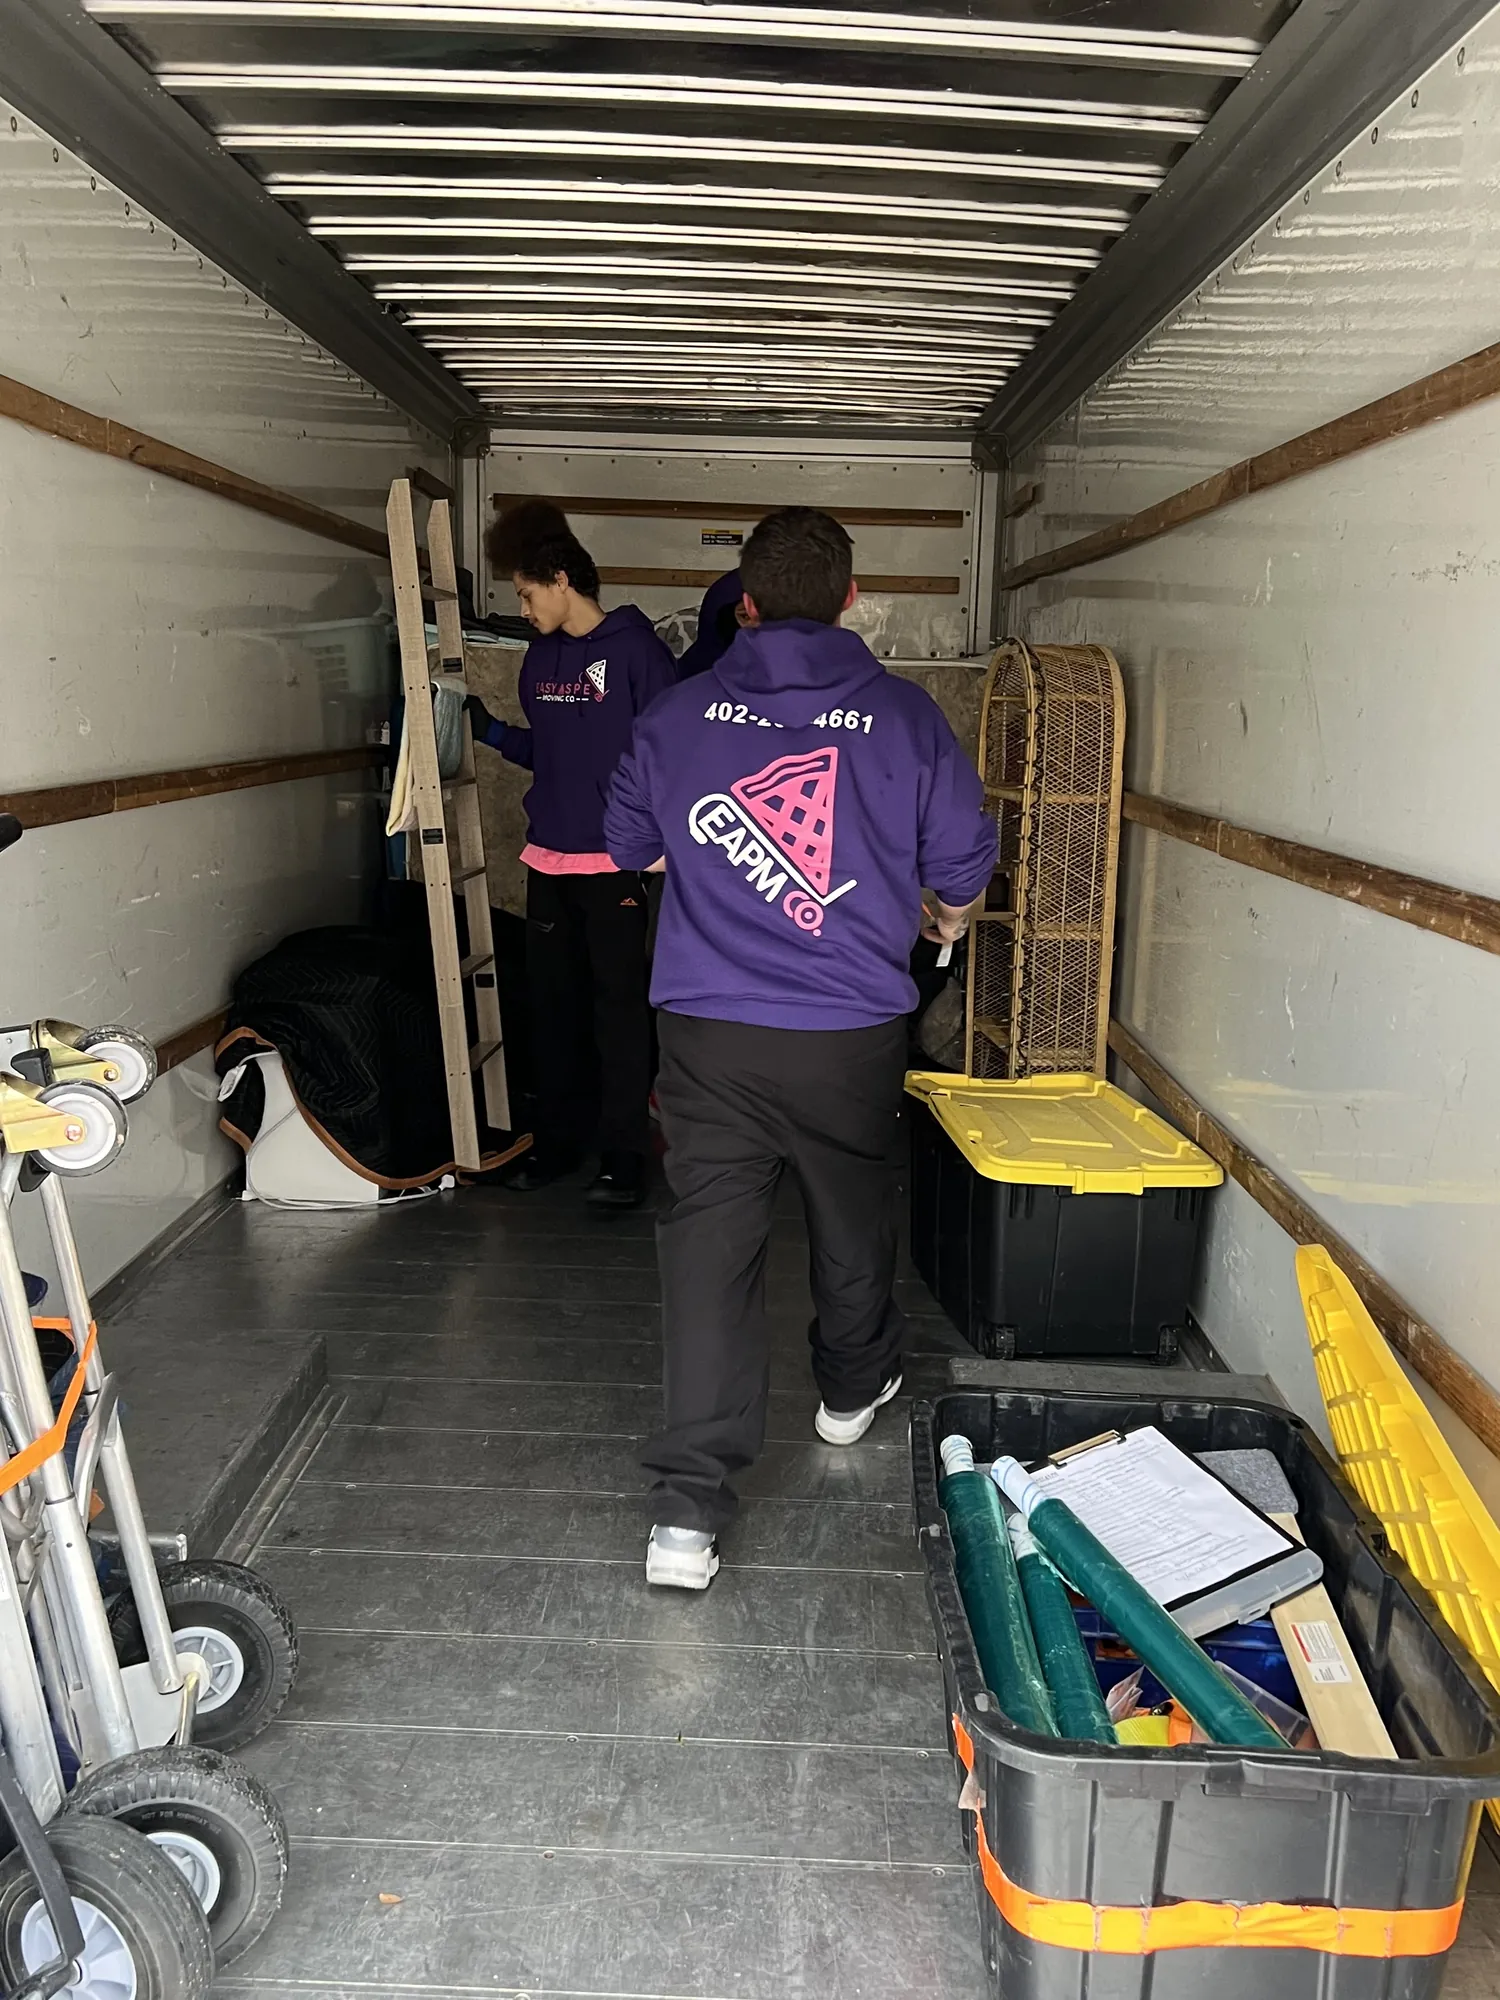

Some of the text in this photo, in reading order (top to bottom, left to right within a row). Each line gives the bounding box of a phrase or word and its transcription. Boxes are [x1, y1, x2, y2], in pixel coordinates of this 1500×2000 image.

[536, 682, 557, 694] EASY
[574, 683, 590, 695] PE
[542, 694, 564, 702] MOVING
[697, 802, 789, 903] EAPM
